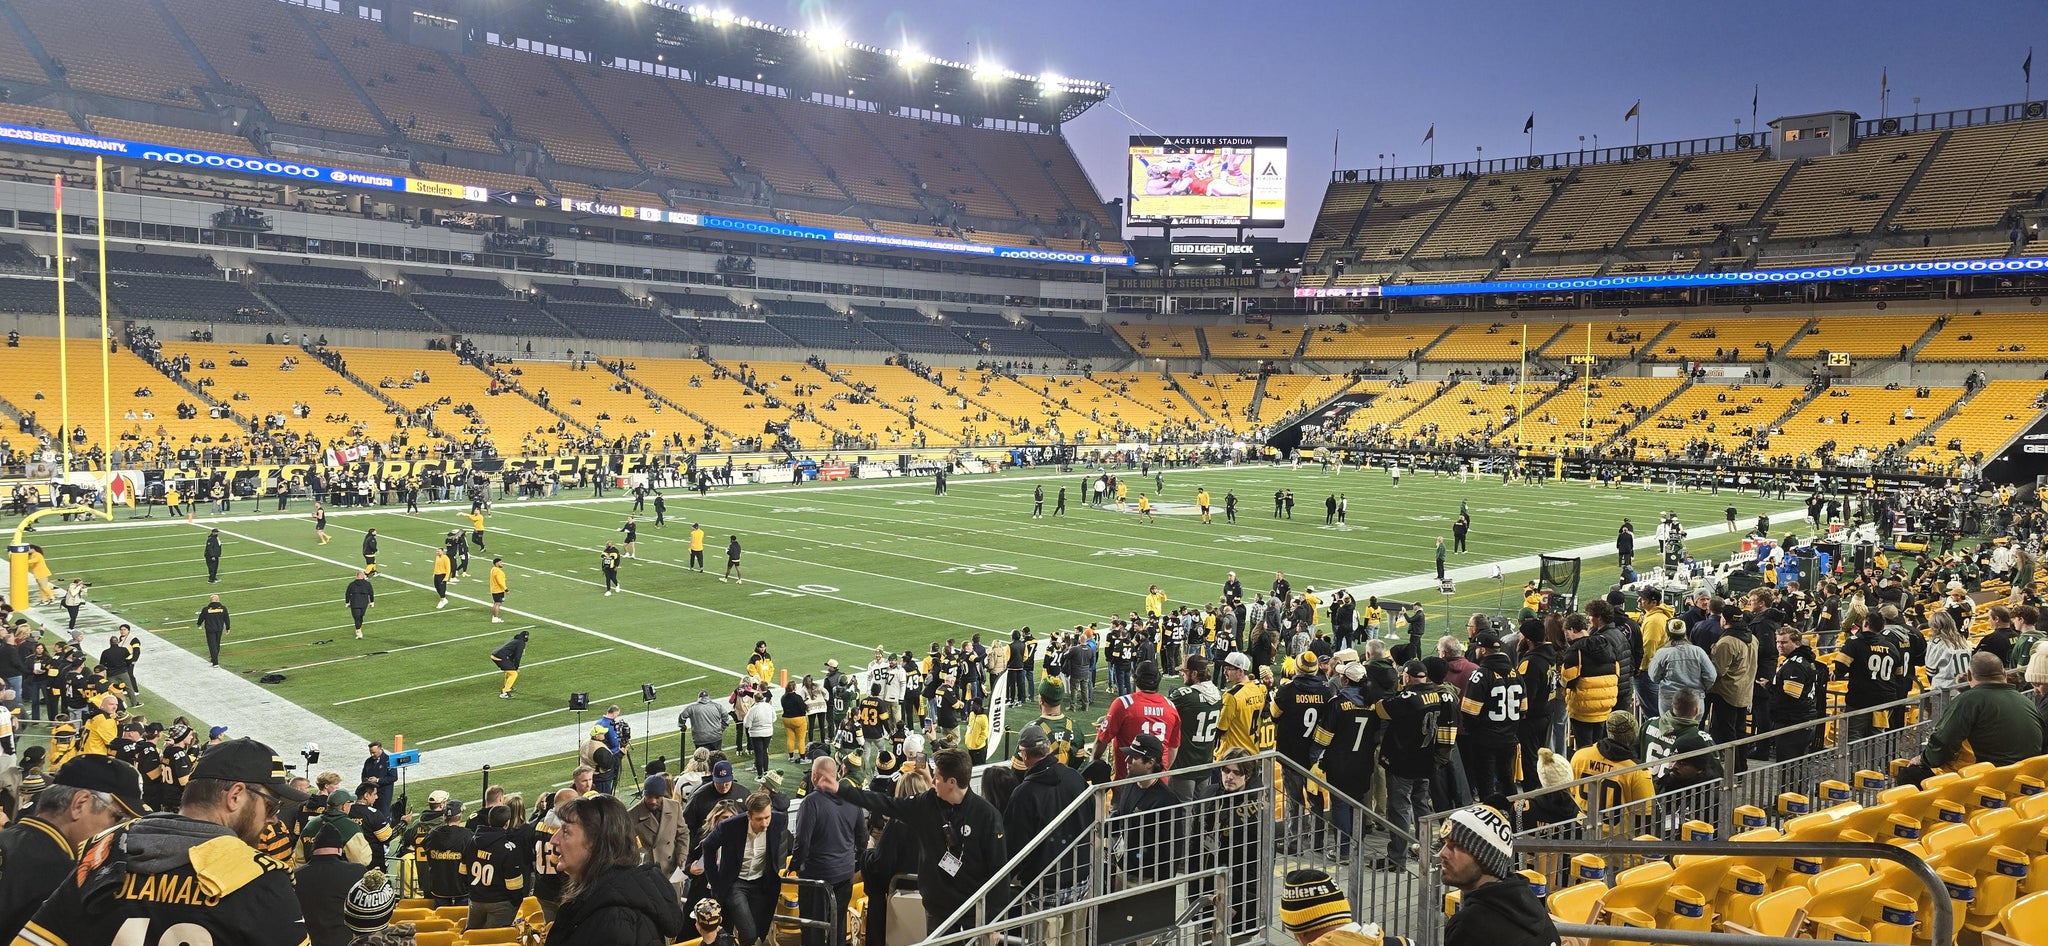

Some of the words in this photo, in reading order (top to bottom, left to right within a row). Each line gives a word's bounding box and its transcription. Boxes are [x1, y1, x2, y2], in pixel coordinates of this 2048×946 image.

[34, 131, 60, 144] BEST
[60, 136, 128, 153] WARRANTY.
[348, 174, 393, 187] HYUNDAI
[416, 181, 453, 197] Steelers
[473, 189, 480, 199] 0
[575, 201, 591, 213] 1ST
[594, 202, 618, 216] 14:44
[1173, 245, 1194, 253] BUD
[1194, 245, 1224, 253] LIGHT
[1226, 245, 1254, 253] DECK
[1122, 279, 1137, 288] THE
[1139, 279, 1164, 288] HOME
[1166, 278, 1176, 288] OF
[1179, 276, 1221, 288] STEELERS
[1223, 275, 1256, 287] NATION
[1830, 354, 1848, 365] 25
[1216, 638, 1229, 652] 90
[1870, 644, 1890, 654] WATT
[1121, 648, 1132, 660] 36
[1867, 654, 1894, 682] 90
[1953, 653, 1972, 677] 10
[873, 667, 887, 681] 85
[907, 674, 919, 691] 43
[1295, 694, 1324, 704] BOSWELL
[1488, 684, 1523, 721] 36
[860, 707, 878, 726] 43
[1143, 706, 1164, 716] BRADY
[1191, 709, 1221, 743] 12
[1303, 707, 1318, 738] 9
[1260, 725, 1276, 748] 10
[1352, 717, 1369, 752] 7
[1589, 759, 1614, 773] WATT
[430, 849, 463, 861] Steelers
[477, 849, 492, 861] WATT
[471, 860, 495, 887] 90
[353, 882, 394, 908] PENGUINS
[1284, 884, 1329, 899] eelers
